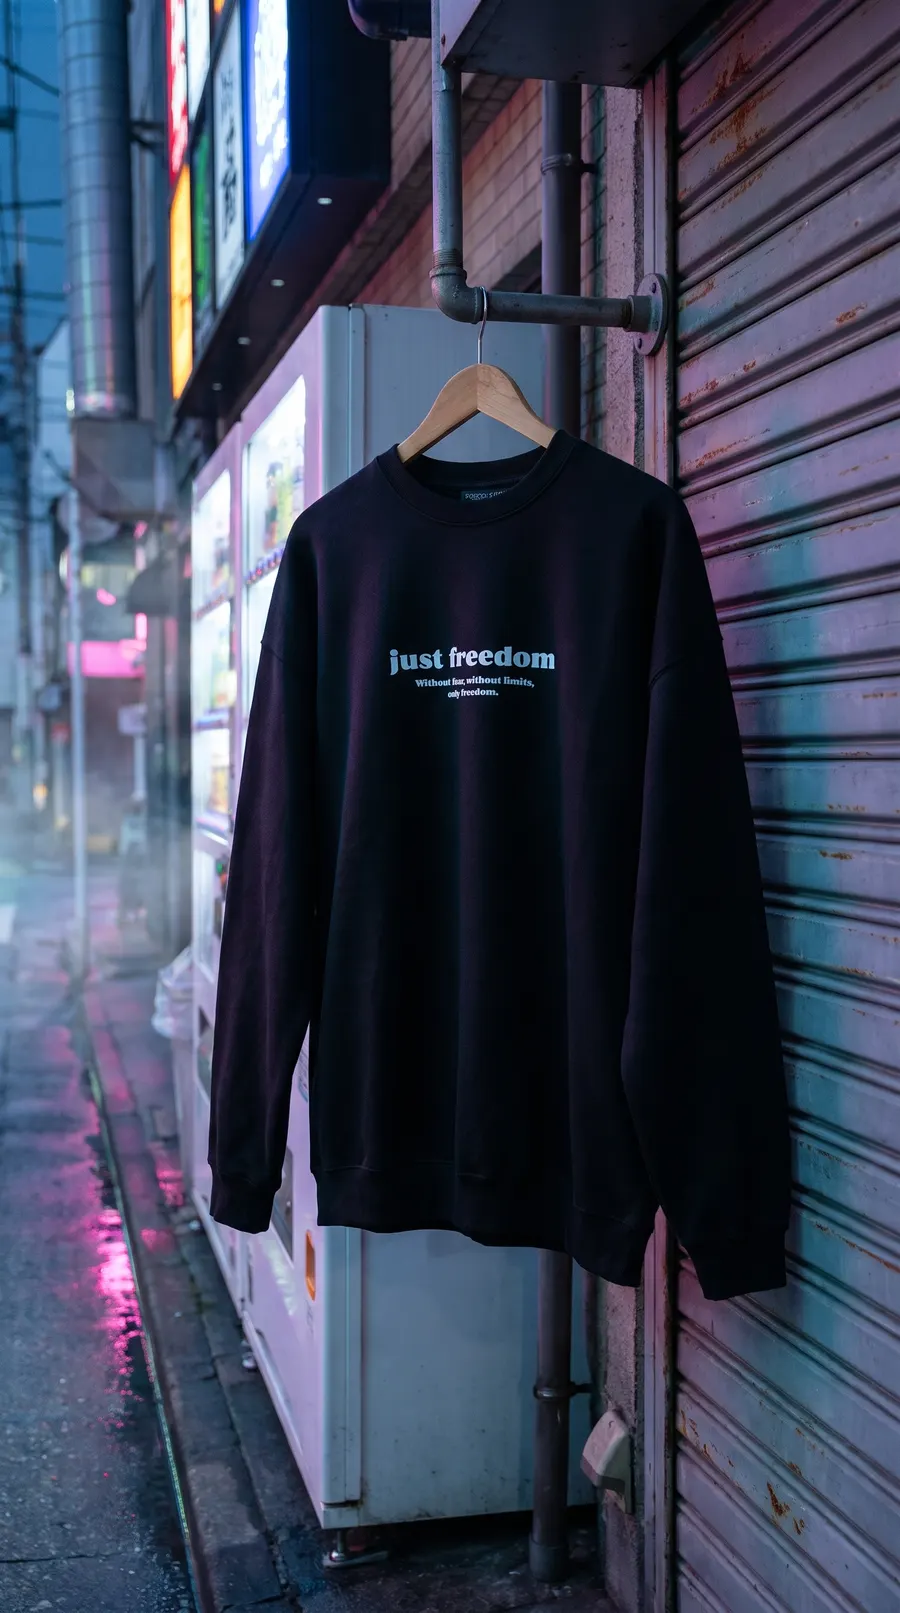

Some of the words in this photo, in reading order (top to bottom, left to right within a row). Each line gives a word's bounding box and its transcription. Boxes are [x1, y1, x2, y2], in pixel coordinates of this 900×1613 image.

[389, 648, 444, 675] just
[449, 646, 556, 670] freedom
[415, 678, 451, 688] Without
[466, 675, 502, 685] without
[503, 676, 535, 688] limits,
[447, 690, 460, 699] only
[460, 688, 499, 697] freedom.
